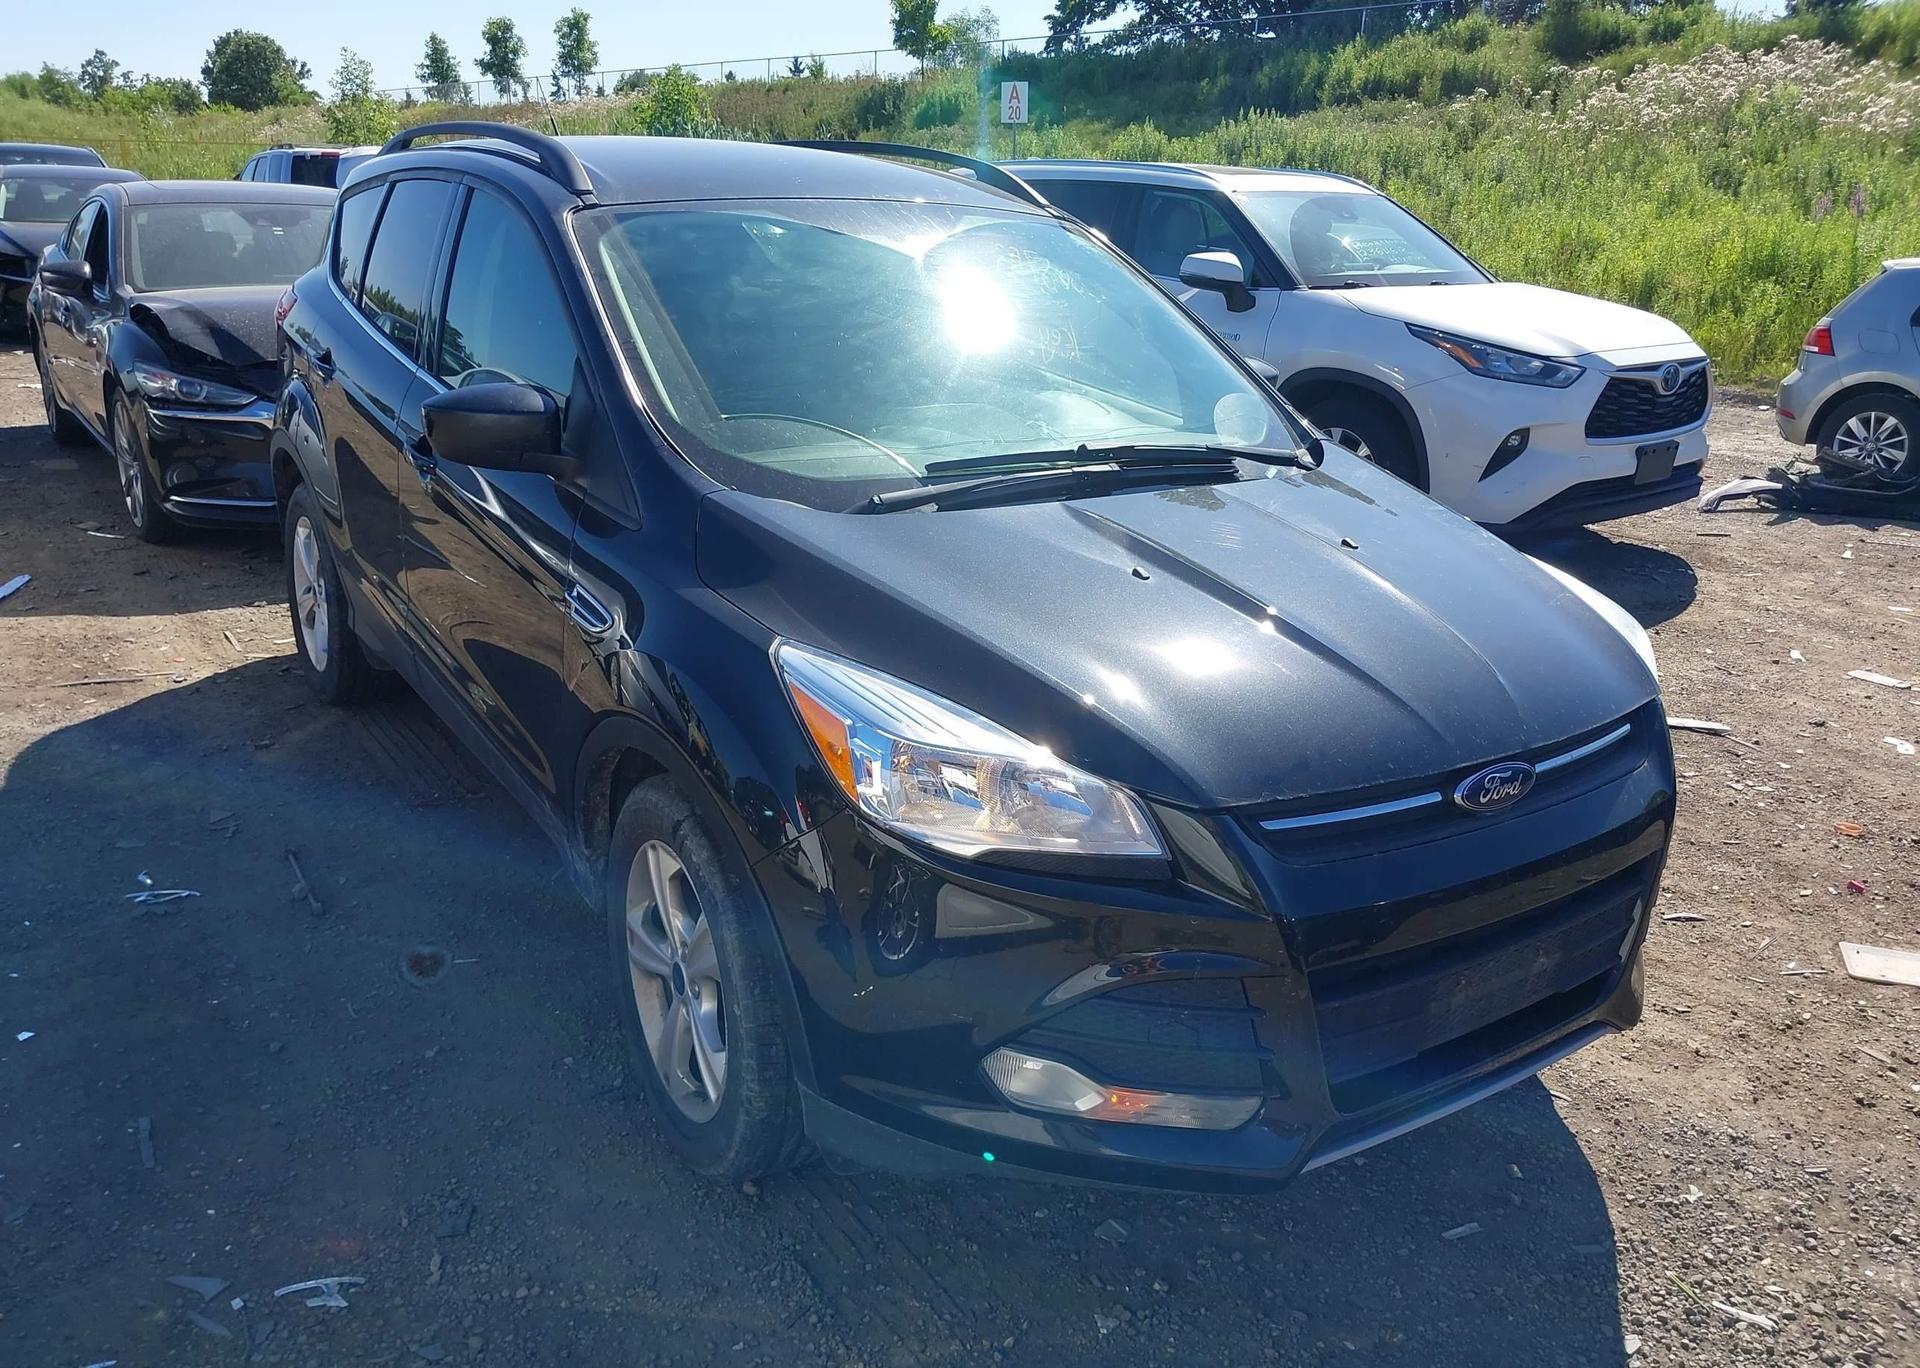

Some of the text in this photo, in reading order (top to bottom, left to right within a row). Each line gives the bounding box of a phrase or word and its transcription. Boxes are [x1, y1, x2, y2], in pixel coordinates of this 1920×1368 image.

[1008, 83, 1020, 104] A
[1008, 105, 1021, 120] 20
[1480, 771, 1523, 803] Ford
